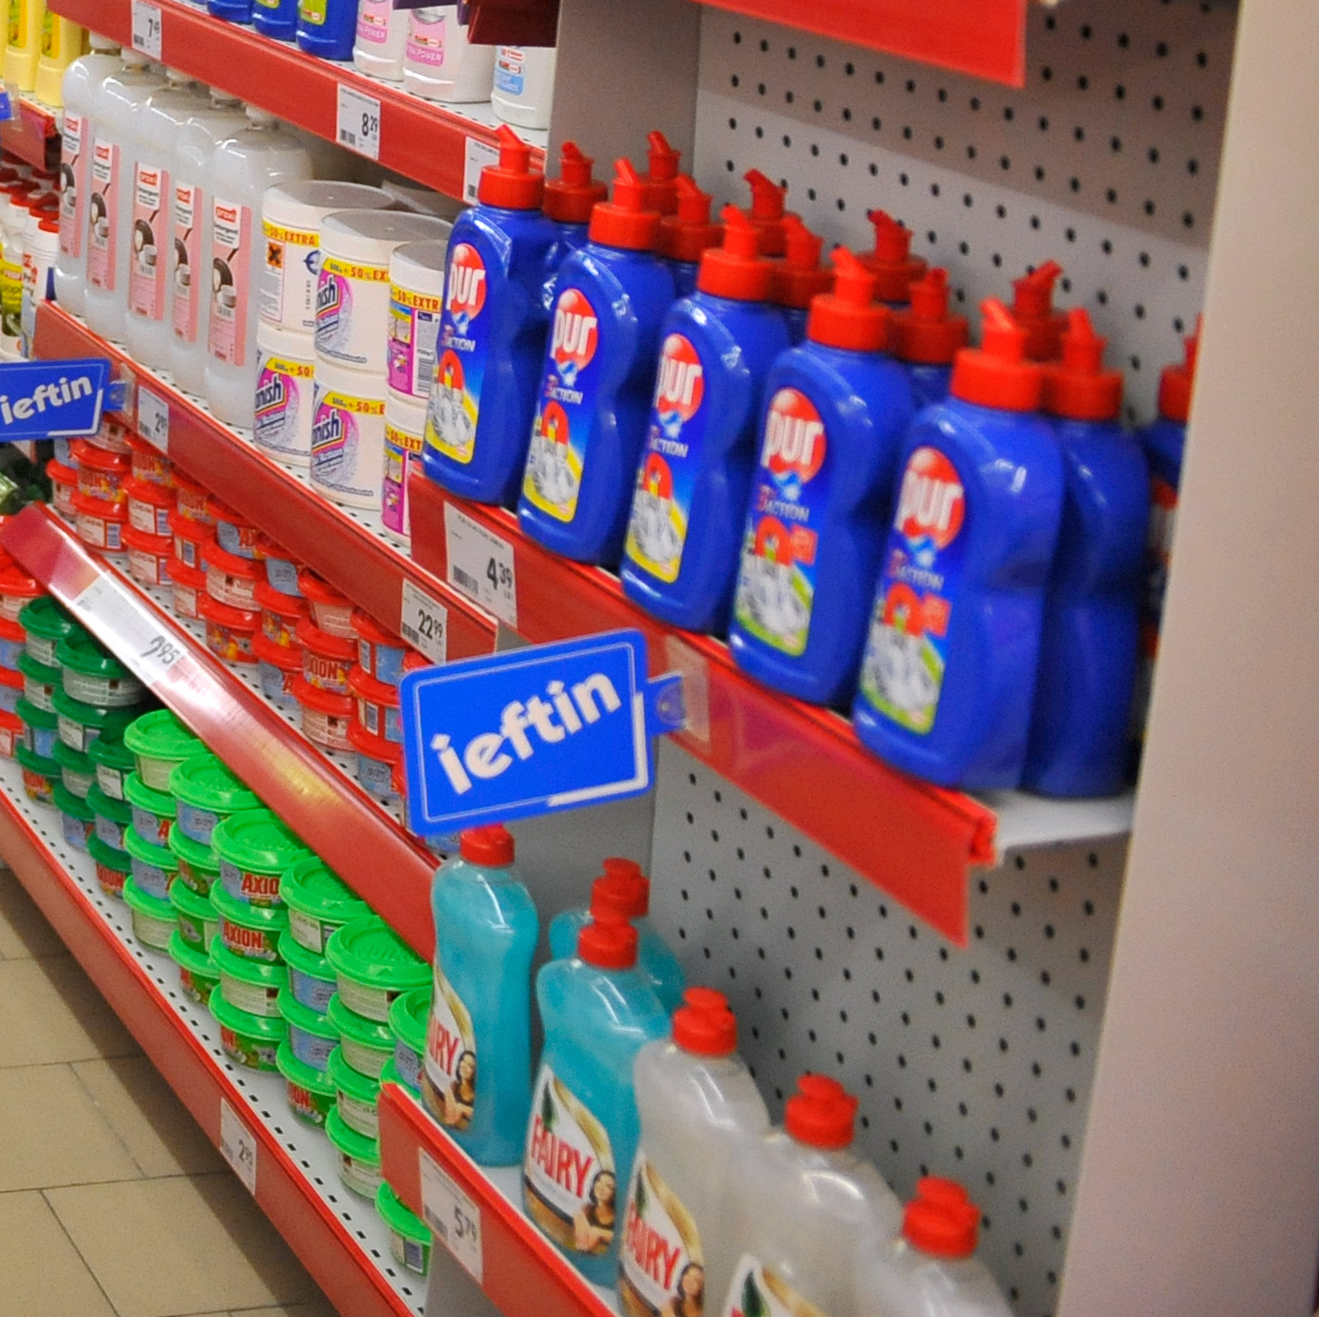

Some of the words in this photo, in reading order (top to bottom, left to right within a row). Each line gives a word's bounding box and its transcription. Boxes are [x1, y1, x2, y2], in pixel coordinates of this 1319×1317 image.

[283, 230, 317, 247] EXTRA
[412, 294, 440, 313] EXTR
[446, 262, 486, 316] pur
[553, 312, 597, 366] pur
[657, 358, 704, 414] pur
[764, 413, 824, 475] pur
[897, 468, 963, 532] pur
[428, 670, 624, 796] ieftin
[242, 872, 280, 895] AXIO
[222, 921, 264, 950] AXION
[529, 1114, 593, 1199] FAIRY
